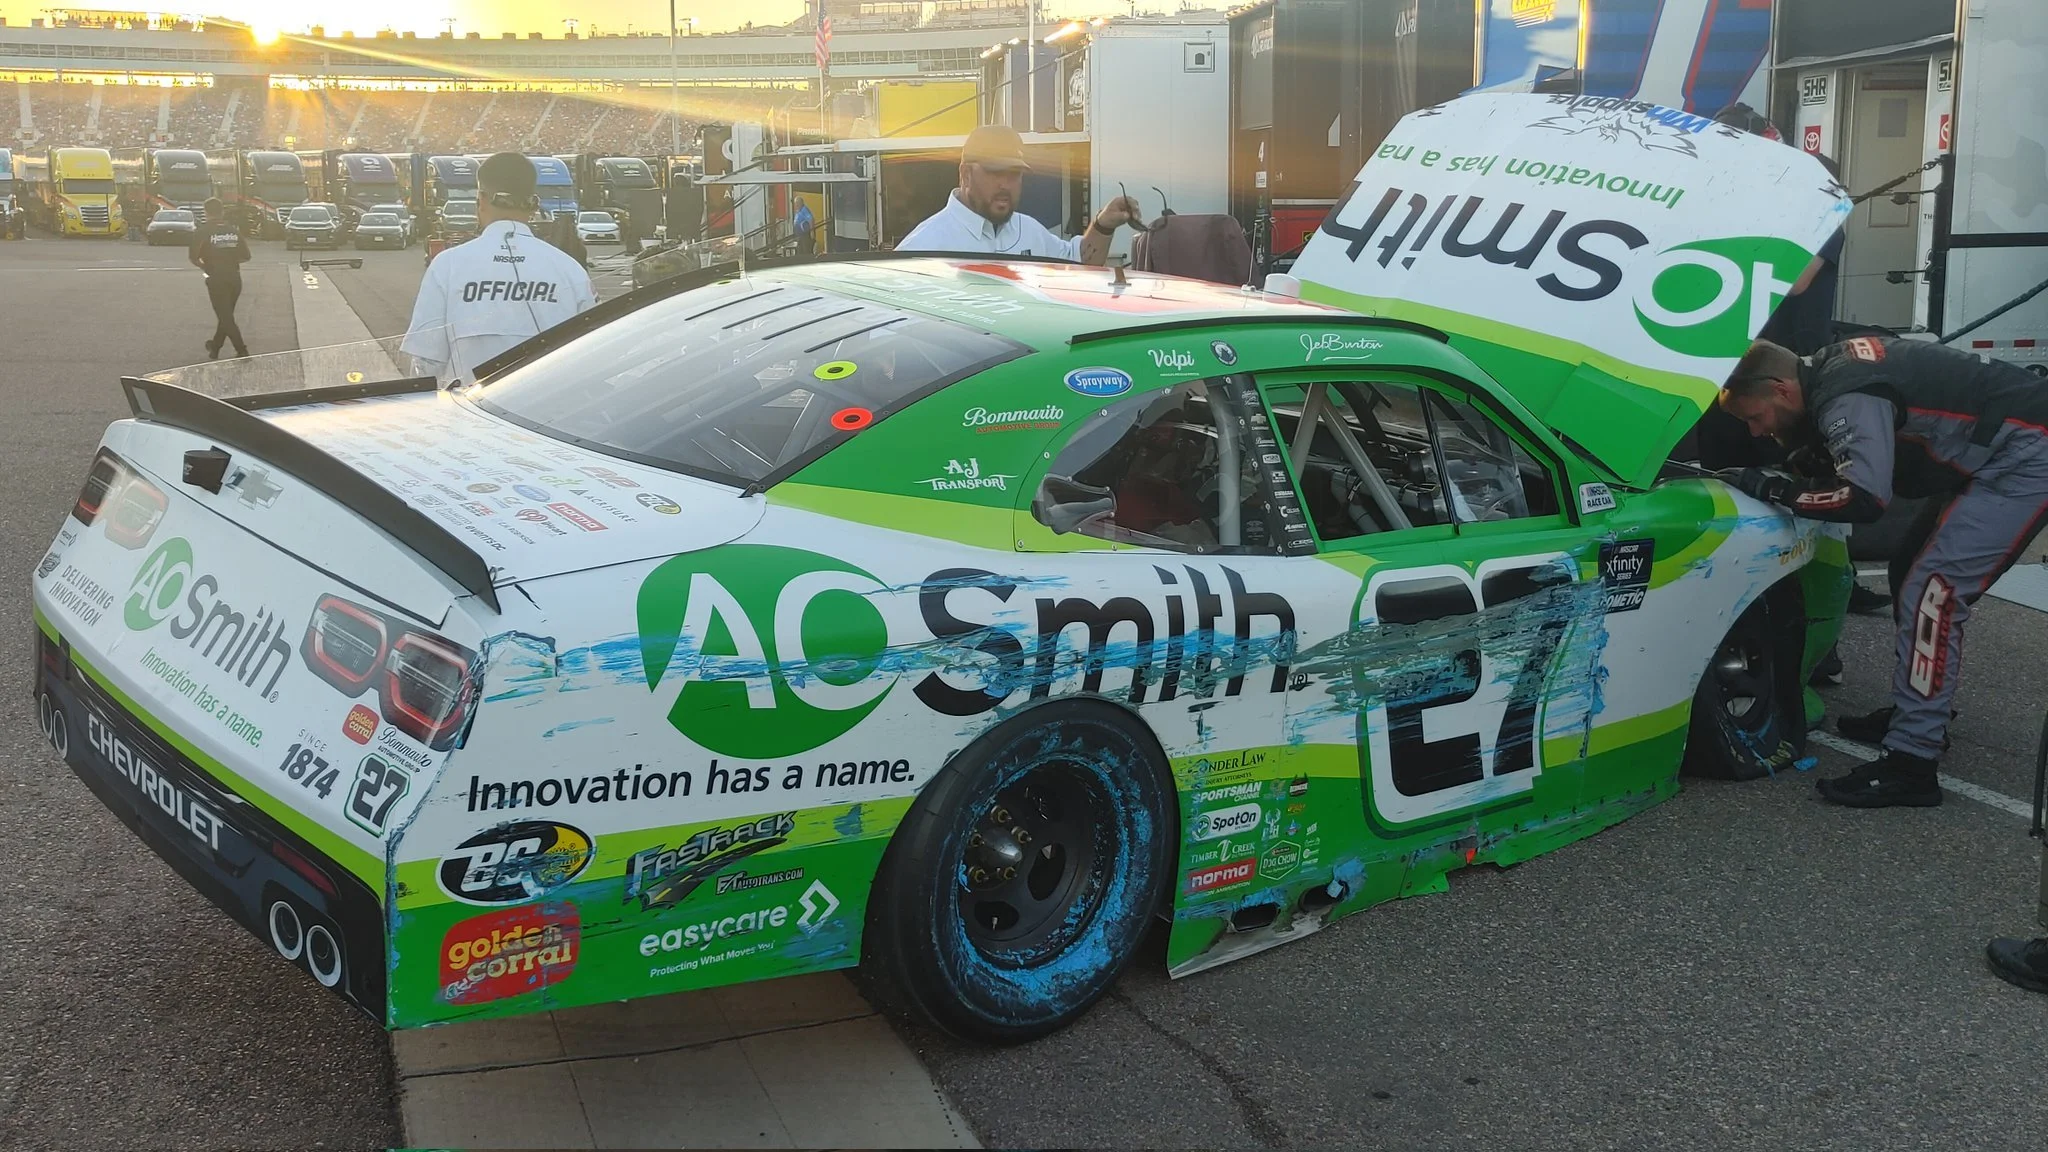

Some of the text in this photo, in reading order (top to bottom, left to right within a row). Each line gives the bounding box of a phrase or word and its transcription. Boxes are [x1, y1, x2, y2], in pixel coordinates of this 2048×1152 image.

[1804, 79, 1826, 97] SHR
[1421, 149, 1441, 168] a
[1447, 153, 1499, 176] has
[1505, 157, 1686, 210] Innovation
[1319, 179, 1650, 301] Smith
[493, 255, 526, 263] NASCAR
[463, 280, 558, 303] OFFICIAL
[1300, 334, 1383, 361] Jeb Burton
[1148, 350, 1195, 371] Volpi
[1076, 375, 1123, 389] Sprayway
[962, 405, 1064, 427] Bommarito
[976, 422, 1032, 434] AUTOMOTIVE
[1587, 496, 1612, 507] RACE CAR
[1796, 486, 1850, 504] ECR
[555, 503, 598, 530] norma
[584, 495, 634, 523] ACRISURE
[1618, 545, 1639, 553] NASCAR
[1606, 555, 1644, 577] xfinity
[1616, 572, 1632, 580] SERIES
[62, 564, 115, 610] DELIVERING
[48, 580, 103, 627] INNOVATION
[1604, 590, 1645, 609] OMETIC
[170, 574, 292, 699] Smith
[912, 563, 1296, 717] Smith
[1910, 578, 1948, 697] ECR
[1376, 564, 1574, 797] 27
[140, 646, 263, 748] Innovation has a name.
[348, 721, 373, 740] corral
[350, 711, 374, 729] golden
[298, 728, 328, 753] SINCE
[377, 726, 433, 768] Bommarito
[378, 745, 406, 767] AUTOMOTIVE
[88, 713, 224, 851] CHEVROLET
[279, 743, 341, 800] 1874
[352, 756, 408, 828] 27
[466, 757, 916, 812] Innovation has a name.
[1212, 811, 1257, 831] SpotOn
[1191, 850, 1218, 864] TIMBER
[1232, 842, 1256, 854] CREEK
[1263, 852, 1298, 869] DOG CHOW
[1191, 864, 1249, 888] norma
[639, 905, 789, 957] easycare
[448, 922, 562, 970] golden
[466, 938, 572, 982] corral
[650, 959, 698, 978] Protecting
[700, 950, 726, 966] What
[726, 946, 756, 960] Moves
